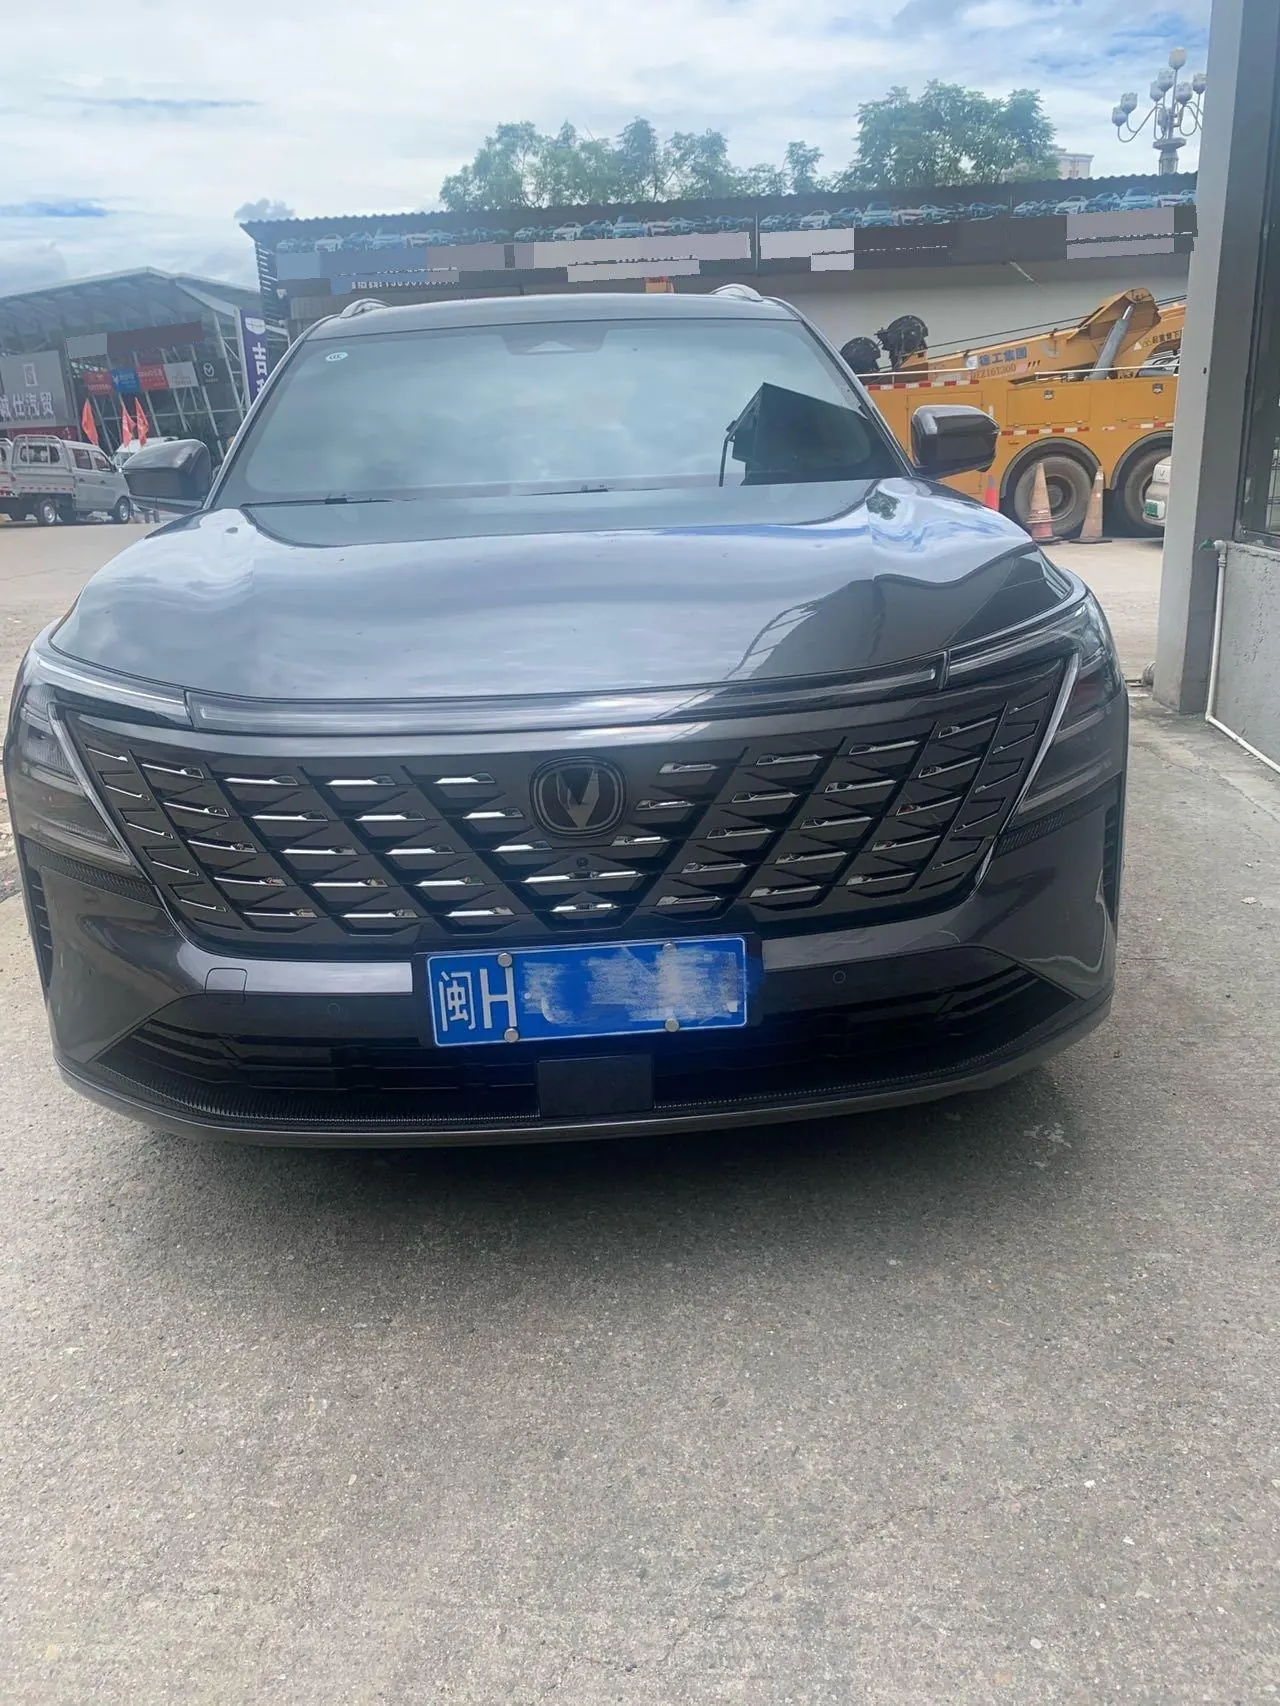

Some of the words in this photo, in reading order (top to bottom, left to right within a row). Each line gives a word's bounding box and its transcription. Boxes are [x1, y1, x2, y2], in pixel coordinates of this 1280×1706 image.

[1153, 330, 1183, 344] 起重臂下
[979, 346, 1027, 366] 徐工集团
